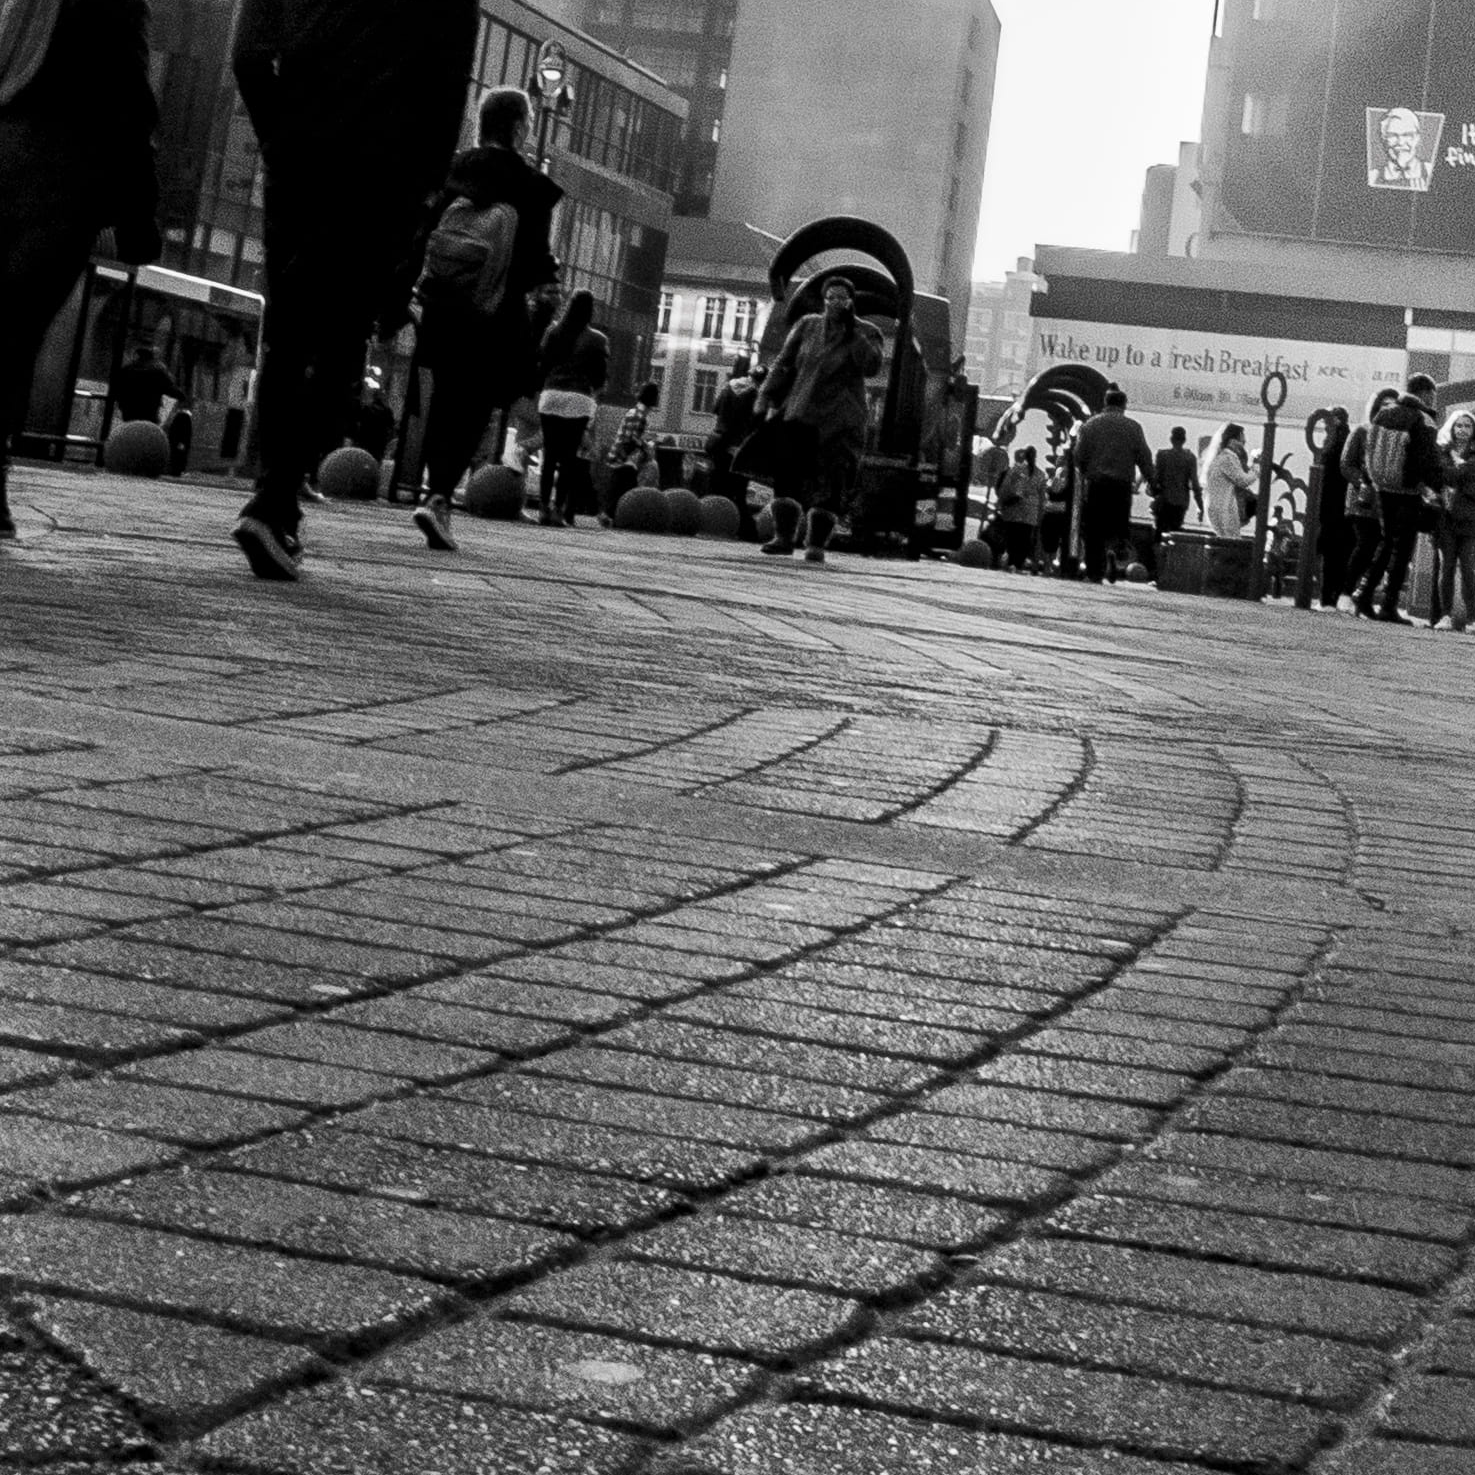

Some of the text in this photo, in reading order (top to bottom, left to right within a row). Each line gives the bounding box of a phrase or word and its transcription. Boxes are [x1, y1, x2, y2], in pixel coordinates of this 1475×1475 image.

[1040, 333, 1090, 361] Wake
[1096, 345, 1120, 368] up
[1125, 344, 1144, 367] to
[1150, 350, 1162, 368] a
[1219, 349, 1309, 382] Breakfast
